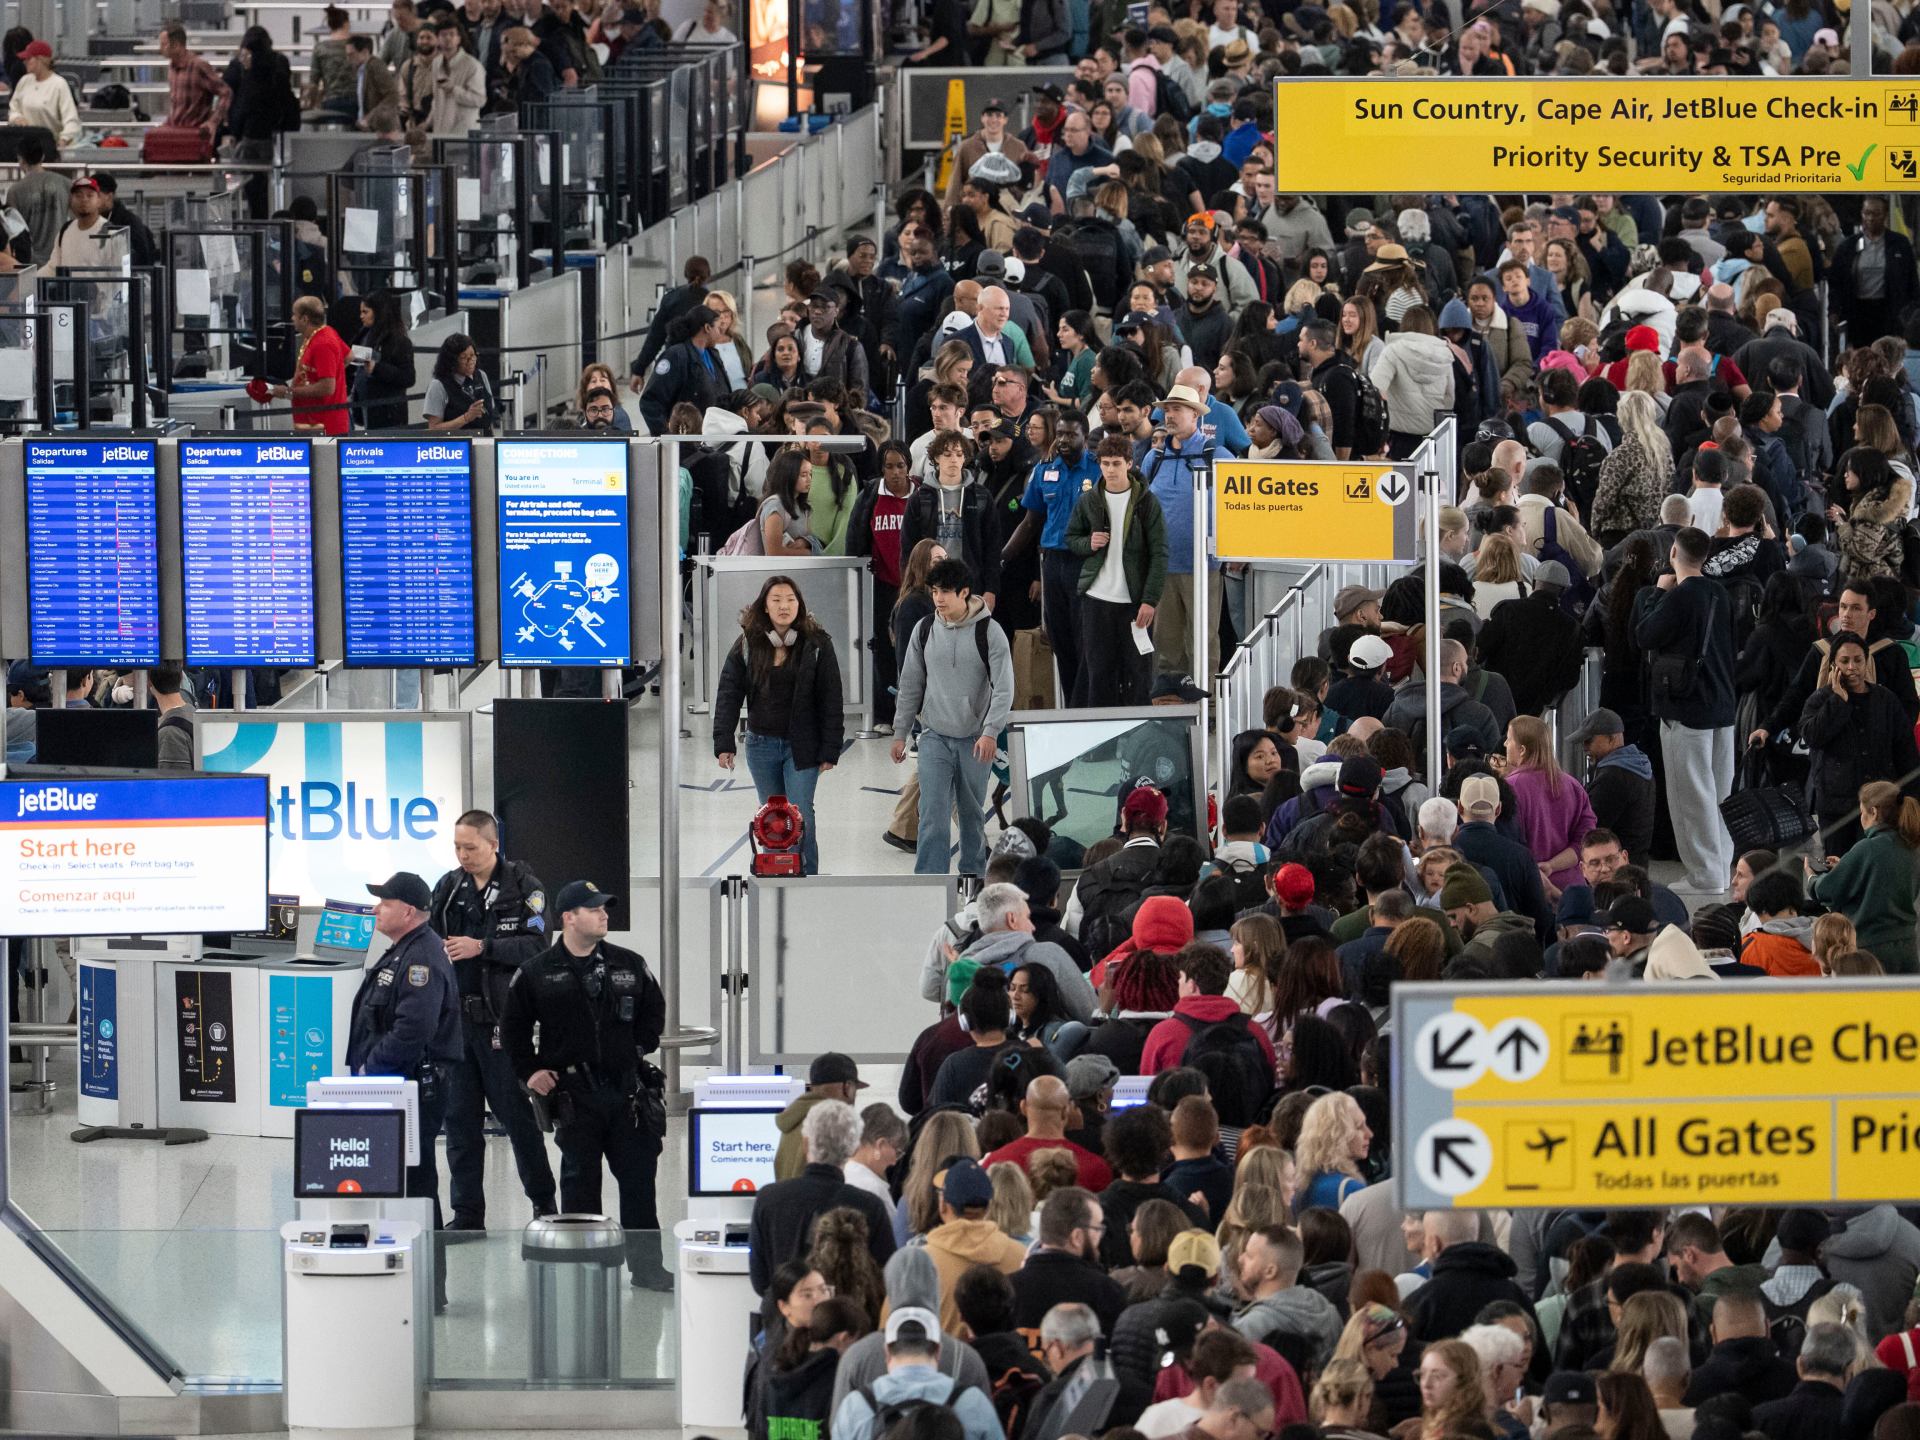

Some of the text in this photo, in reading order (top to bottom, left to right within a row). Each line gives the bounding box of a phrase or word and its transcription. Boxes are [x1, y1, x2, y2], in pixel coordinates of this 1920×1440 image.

[1355, 96, 1877, 125] Sun Country, Cape Air, JetBlue Check-in
[1494, 145, 1840, 172] Priority Security & TSA Pre
[1723, 173, 1841, 185] Seguridad Prioritaria
[32, 447, 88, 458] Departures
[102, 446, 148, 464] jetBlue
[186, 447, 242, 458] Departures
[257, 446, 304, 464] jetBlue
[346, 448, 384, 456] Arrivals
[416, 446, 463, 462] jetBlue
[610, 476, 616, 486] 5
[1224, 476, 1318, 496] All Gates
[1224, 502, 1304, 514] Todas las puertas
[875, 515, 904, 531] HARV
[18, 787, 96, 817] jetBlue
[270, 782, 439, 840] tBlue
[20, 838, 136, 857] Start here
[19, 862, 60, 871] Check-in
[68, 861, 96, 870] Select
[130, 860, 152, 868] Print
[154, 860, 171, 870] bag
[174, 860, 194, 869] tags
[20, 890, 97, 903] Comenzar
[1644, 1021, 1918, 1067] JetBlue Che
[330, 1138, 369, 1151] Hello!
[1593, 1117, 1816, 1158] All Gates
[713, 1141, 774, 1152] Start here.
[330, 1154, 369, 1170] ¡Hola!
[711, 1155, 753, 1163] Comience
[1594, 1170, 1780, 1193] Todas las puertas
